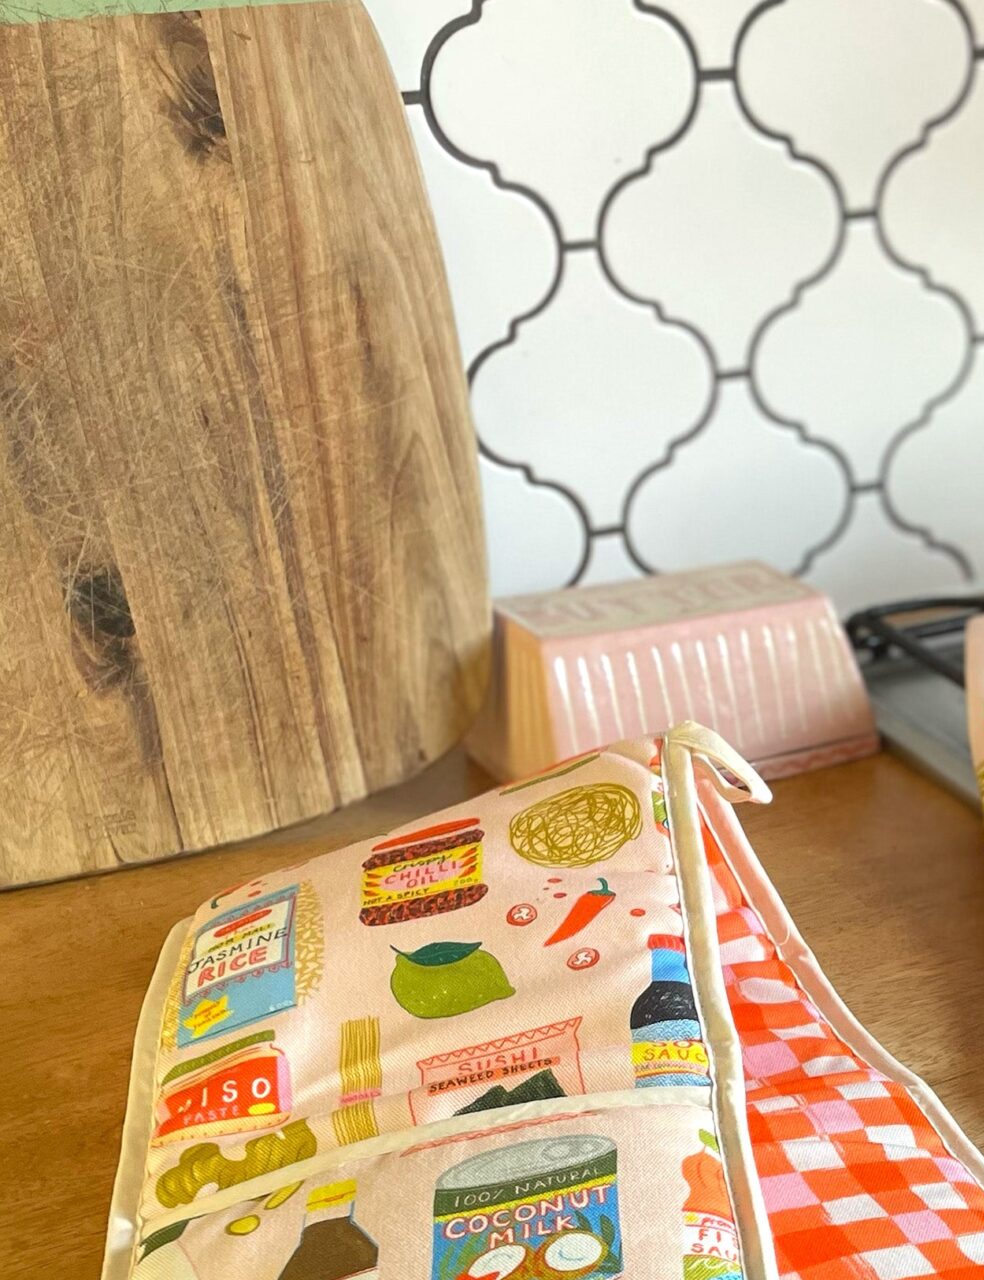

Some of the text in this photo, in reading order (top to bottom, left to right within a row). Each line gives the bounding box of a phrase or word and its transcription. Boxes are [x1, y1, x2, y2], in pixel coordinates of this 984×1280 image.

[384, 861, 457, 884] CHILLI
[407, 875, 438, 888] OIL
[397, 888, 430, 899] SPICY
[189, 927, 288, 974] JASMINE
[197, 947, 268, 987] RICE
[429, 1057, 553, 1093] SEAWEED SHEETS
[458, 1047, 538, 1074] SUSHI
[455, 1167, 600, 1208] 100% NATURAL
[444, 1184, 611, 1240] COCONUT
[489, 1214, 576, 1249] MILK
